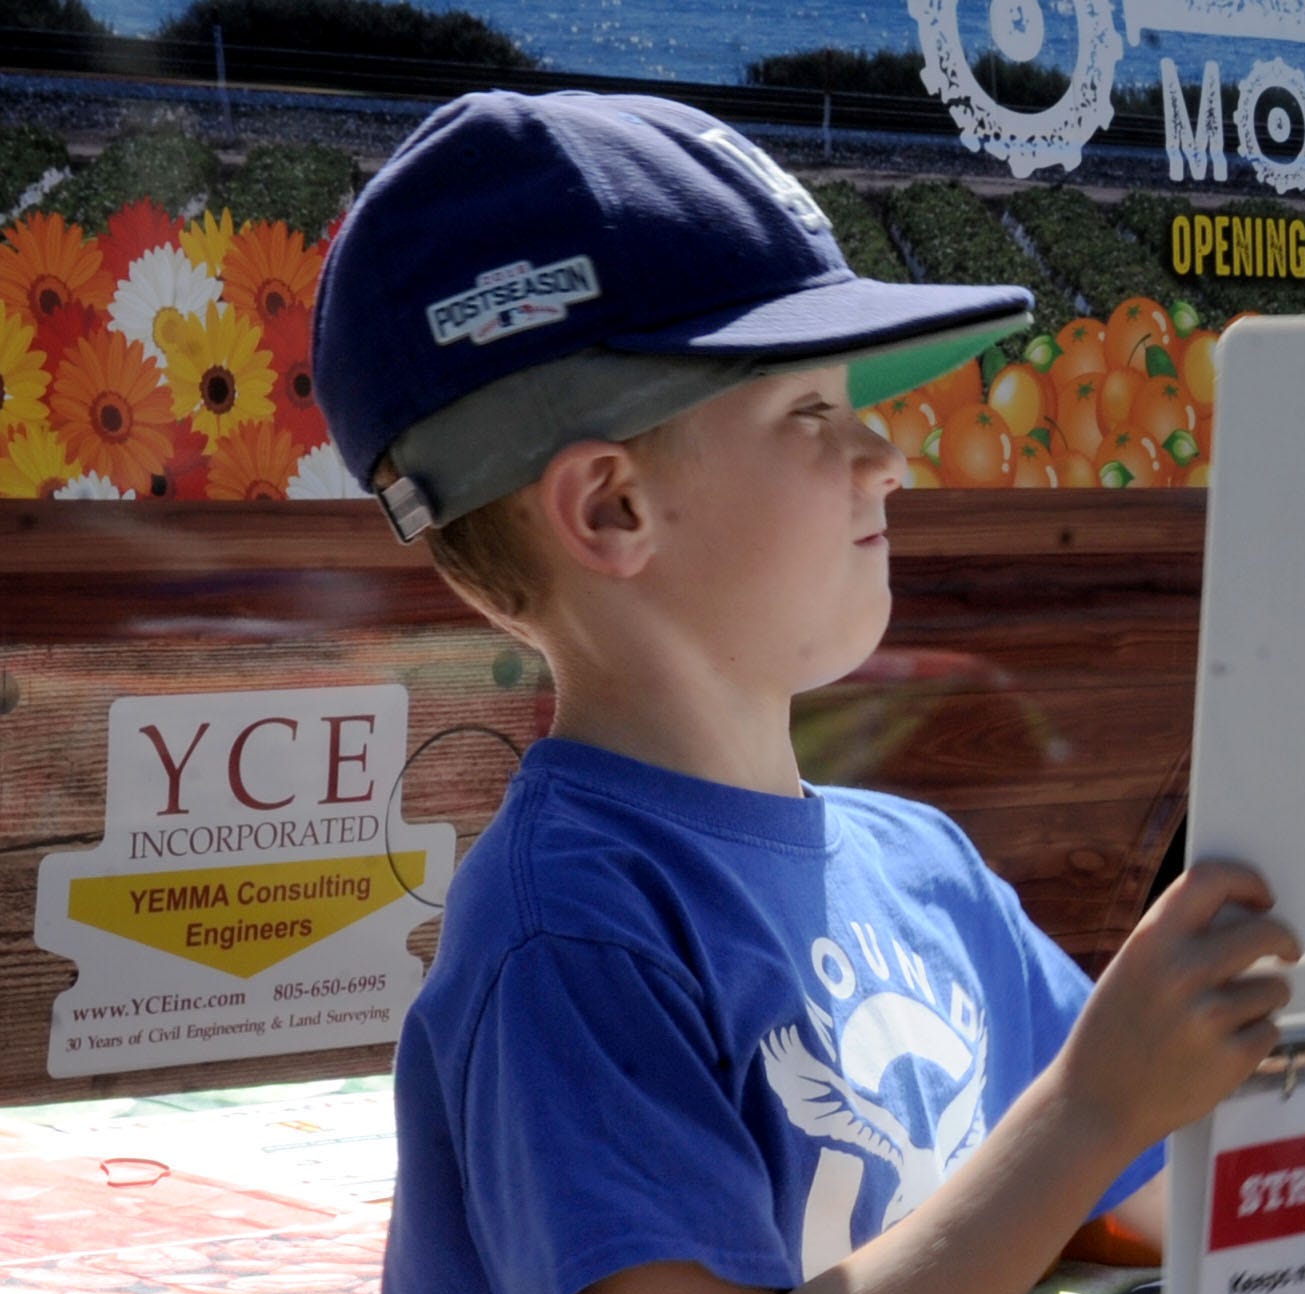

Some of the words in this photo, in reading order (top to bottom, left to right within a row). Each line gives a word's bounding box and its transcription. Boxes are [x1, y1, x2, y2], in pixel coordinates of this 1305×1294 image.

[434, 261, 593, 338] POSTSEASON
[139, 714, 377, 817] YCE
[128, 815, 380, 860] INCORPORATED
[129, 883, 230, 915] YEMMA
[237, 874, 372, 905] Consulting
[186, 918, 313, 950] Engineers
[73, 992, 246, 1022] www.YCEinc.com
[273, 974, 387, 1002] 805-650-6995
[88, 1034, 123, 1049] Years
[128, 1029, 146, 1046] of
[148, 1026, 181, 1044] Civil
[187, 1019, 265, 1041] Engineering
[271, 1016, 283, 1031] &
[289, 1011, 322, 1028] Land
[326, 1006, 390, 1025] Surveying
